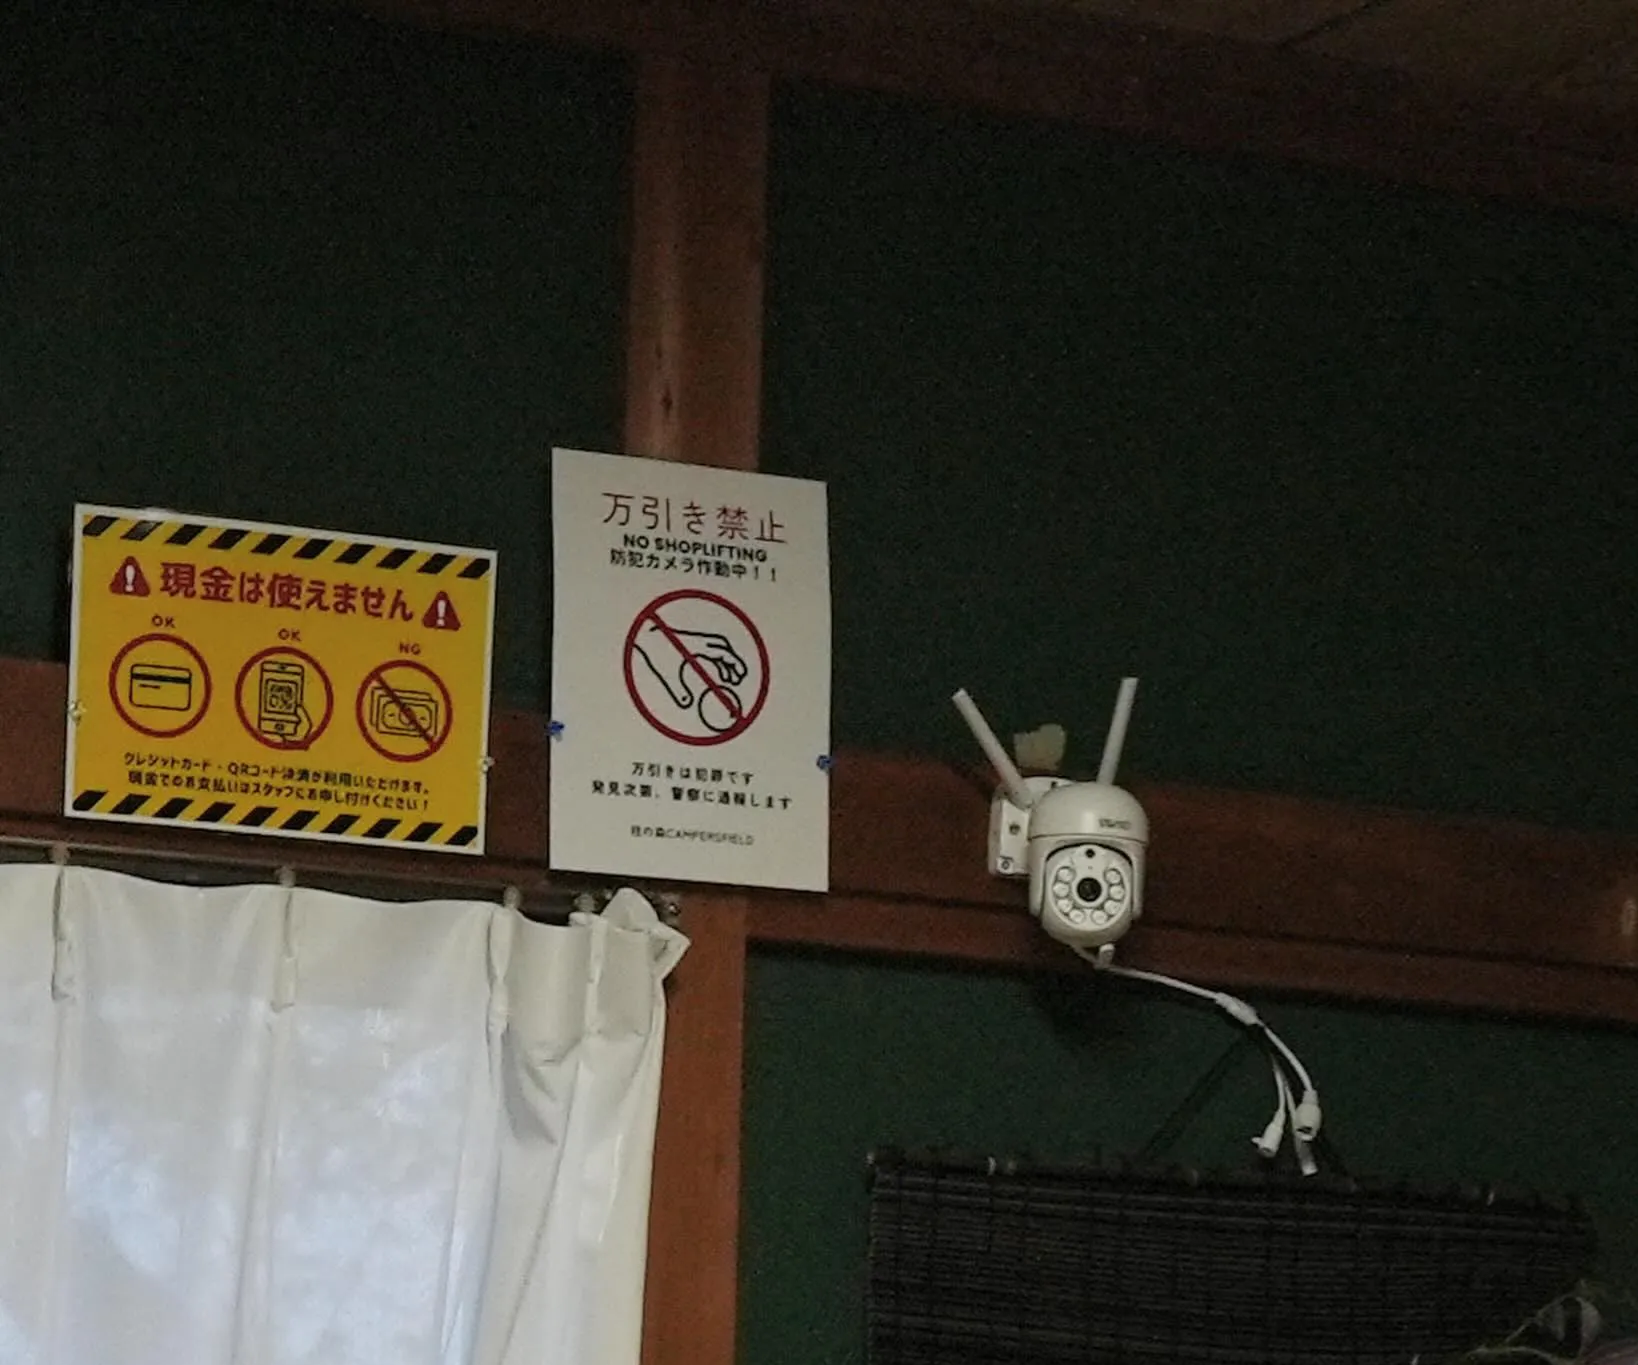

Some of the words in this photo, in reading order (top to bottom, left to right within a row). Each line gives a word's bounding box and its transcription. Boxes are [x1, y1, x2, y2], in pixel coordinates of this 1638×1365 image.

[602, 492, 788, 544] 万引き禁止
[623, 534, 649, 548] NO
[655, 537, 767, 563] SHOPLIFTING
[159, 561, 415, 622] 現金は使えません
[151, 614, 175, 628] OK
[277, 628, 302, 643] OK
[398, 641, 422, 656] NG
[631, 761, 754, 786] 万引きは犯罪です
